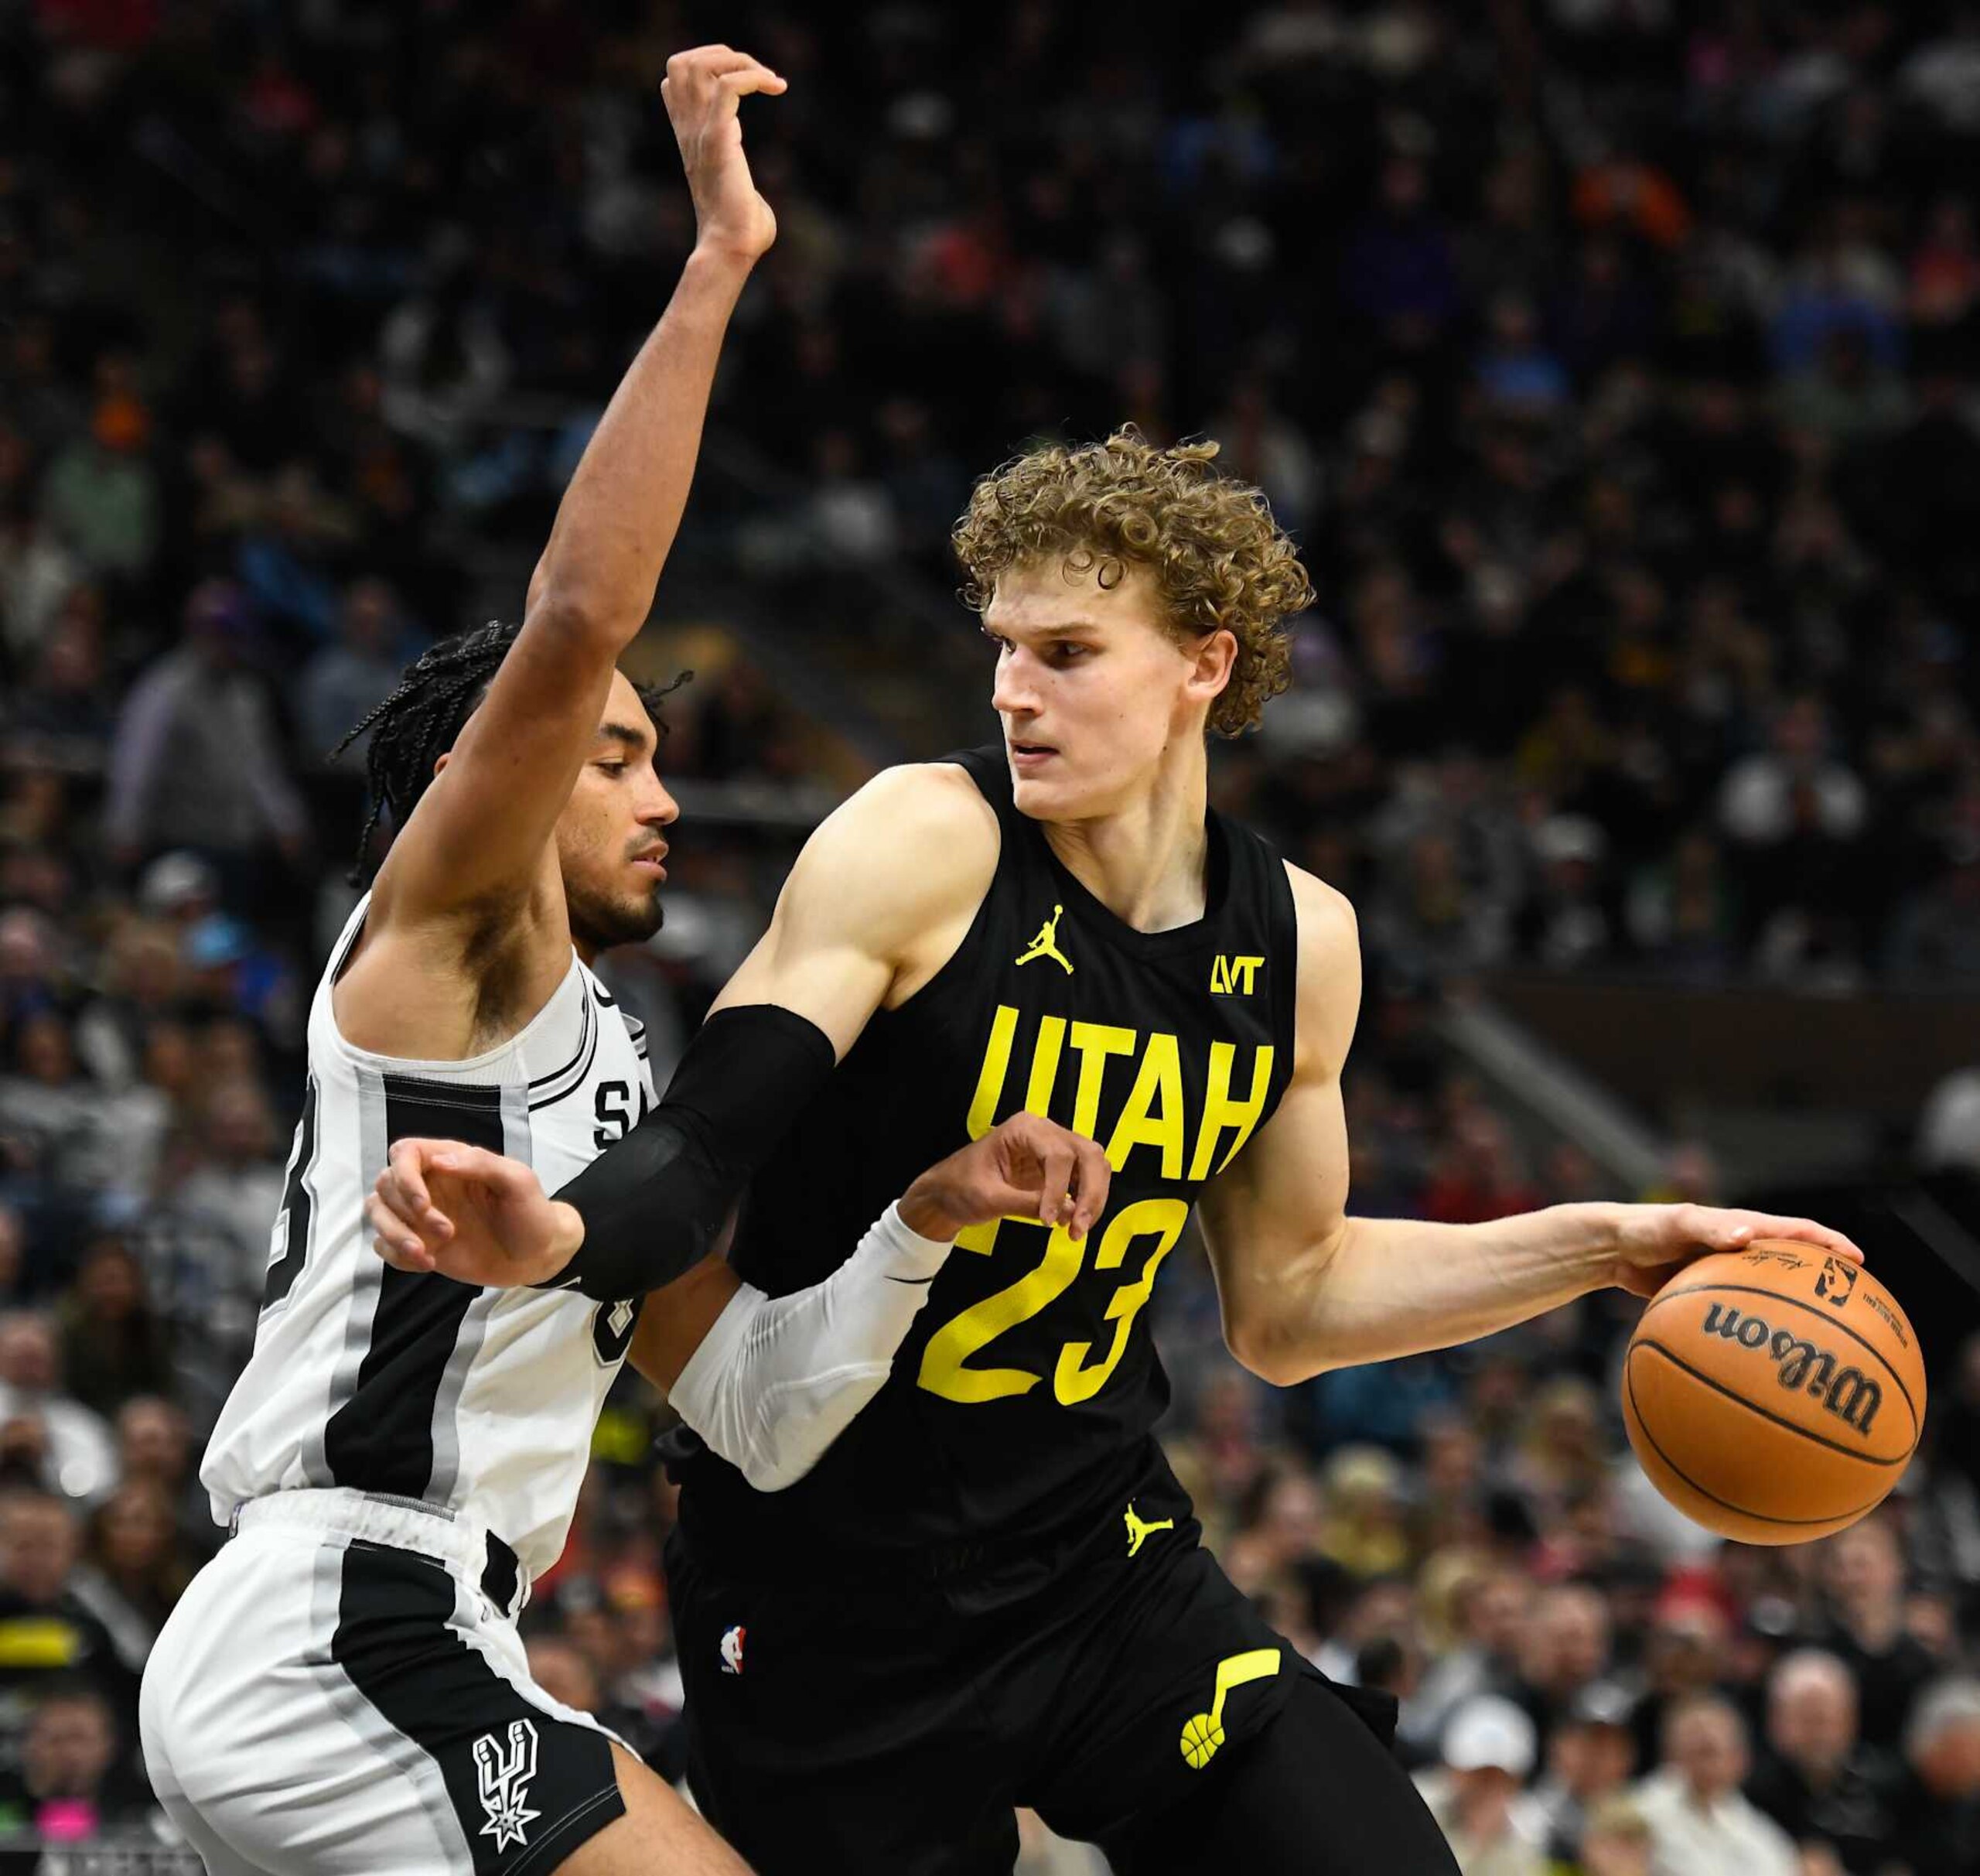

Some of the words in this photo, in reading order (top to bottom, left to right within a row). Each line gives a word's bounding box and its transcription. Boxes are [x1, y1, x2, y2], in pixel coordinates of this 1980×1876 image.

[968, 1005, 1273, 1181] UTAH
[917, 1196, 1189, 1406] 23
[1703, 1303, 1883, 1436] Wilson
